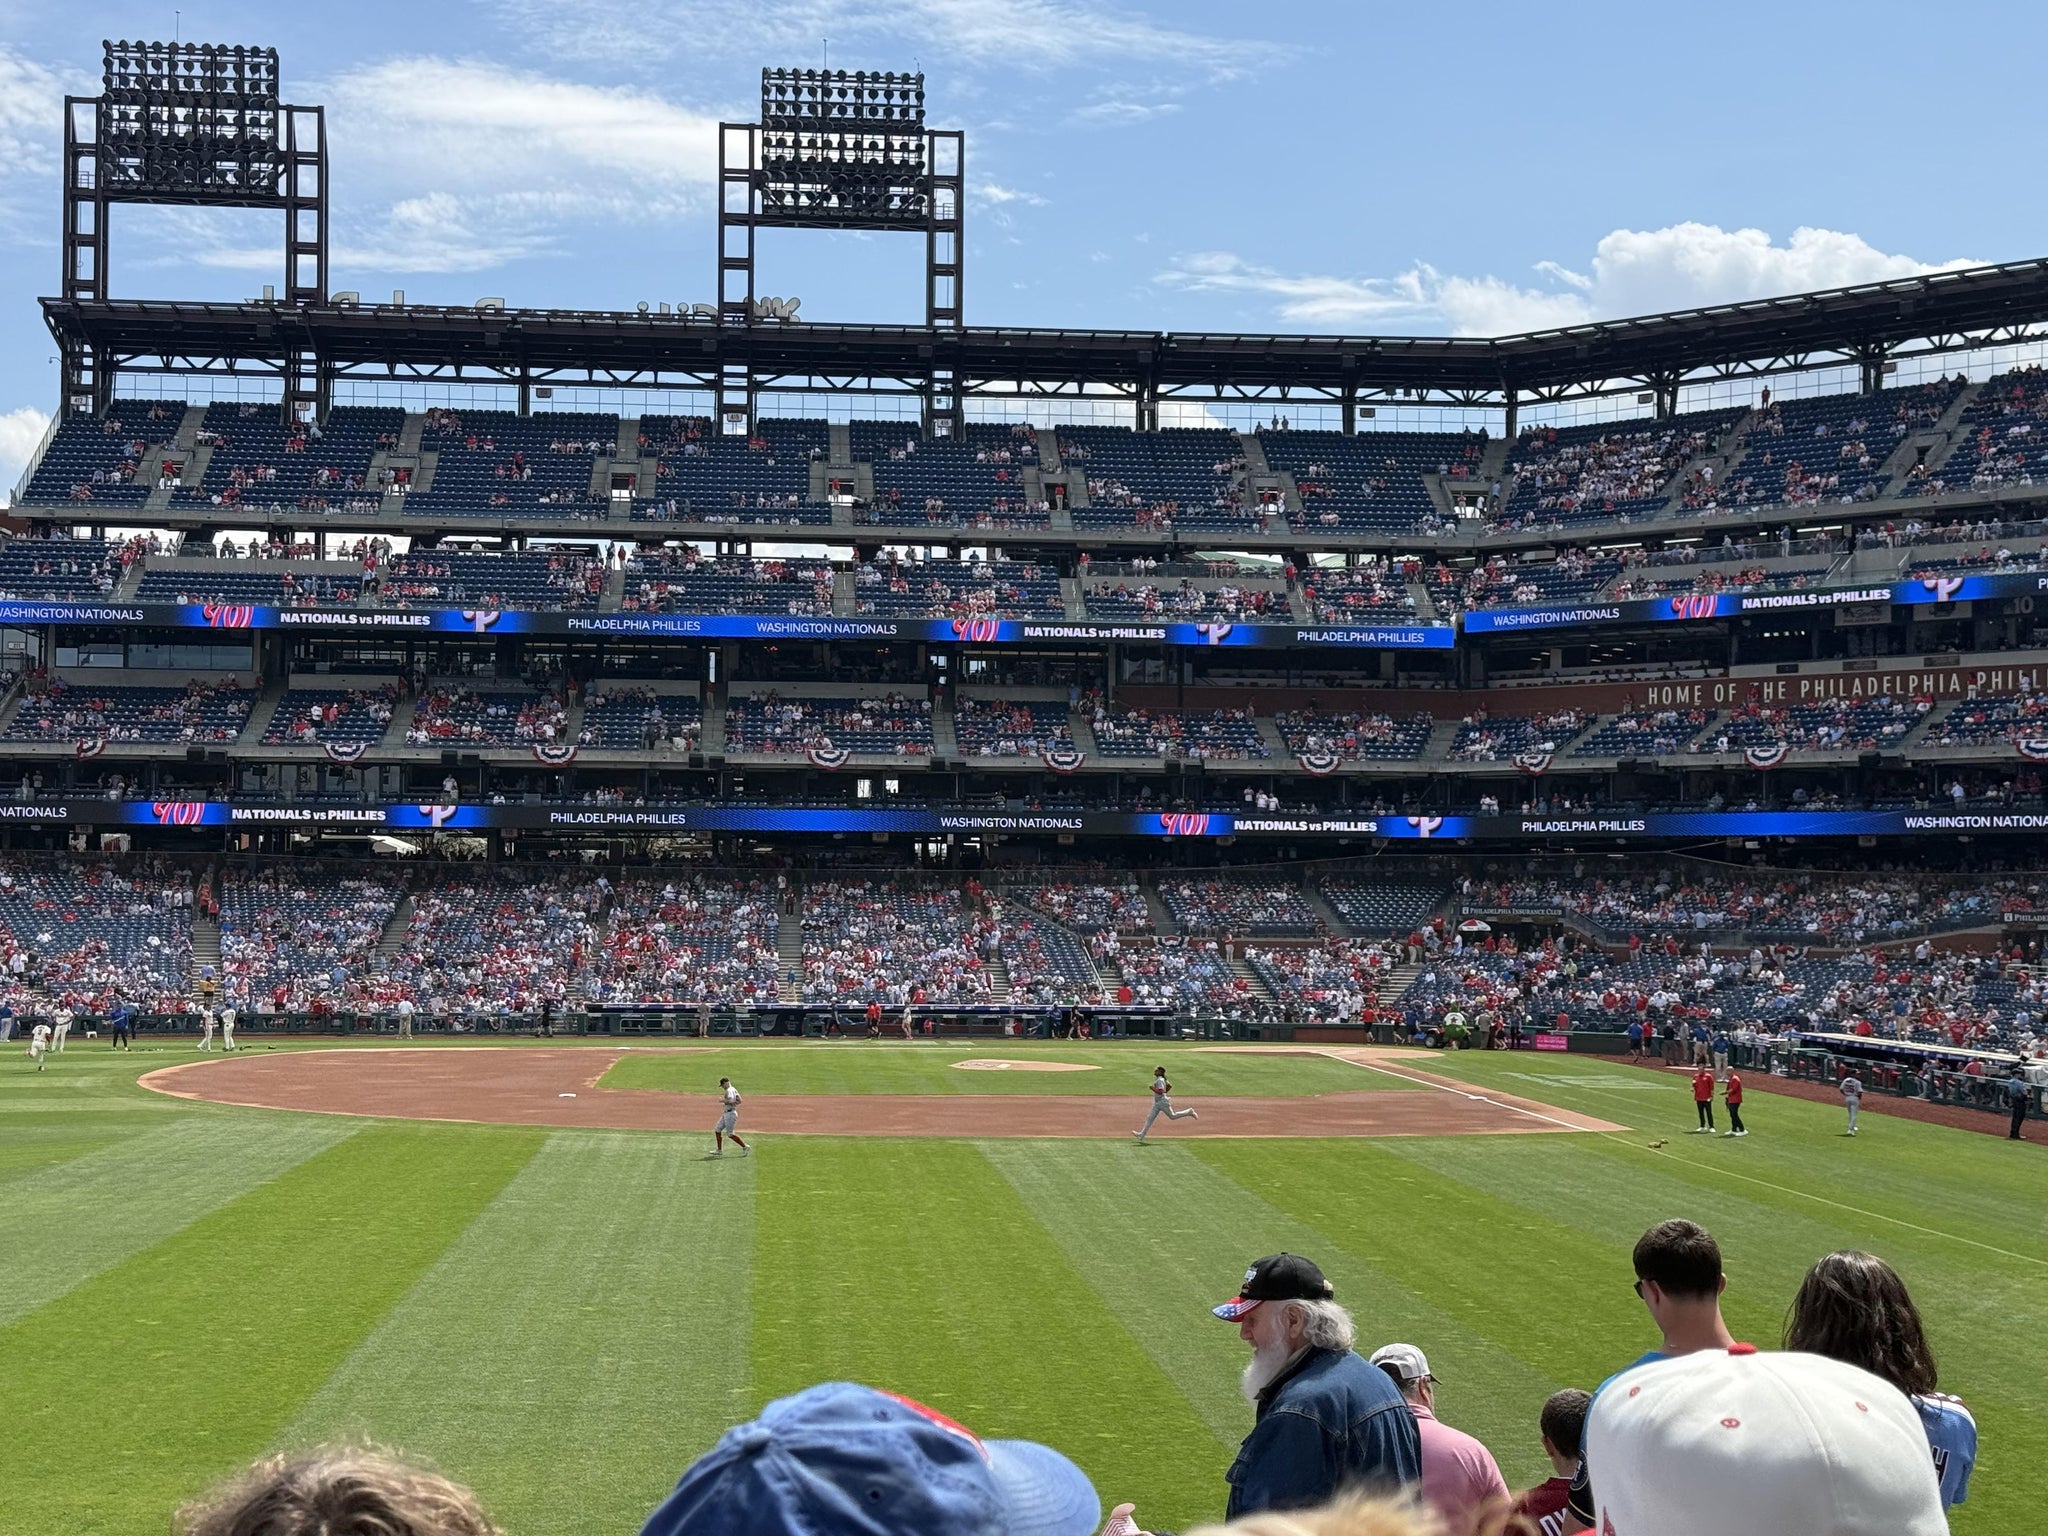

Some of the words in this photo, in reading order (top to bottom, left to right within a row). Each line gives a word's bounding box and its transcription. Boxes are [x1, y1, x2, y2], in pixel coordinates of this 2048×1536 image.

[1742, 594, 1817, 609] NATIONALS
[1818, 595, 1832, 604] vs
[1832, 588, 1891, 603] PHILLIES
[76, 609, 144, 620] NATIONALS
[280, 612, 357, 625] NATIONALS
[359, 616, 372, 625] vs
[374, 615, 431, 625] PHILLIES
[1493, 612, 1560, 626] WASHINGTON
[1561, 608, 1620, 622] NATIONALS
[568, 618, 650, 630] PHILADELPHIA
[652, 620, 700, 631] PHILLIES
[756, 622, 832, 633] WASHINGTON
[834, 624, 897, 635] NATIONALS
[1024, 626, 1097, 638] NATIONALS
[1098, 630, 1111, 639] vs
[1111, 628, 1166, 639] PHILLIES
[1297, 631, 1376, 642] PHILADELPHIA
[1377, 632, 1425, 643] PHILLIES
[1648, 685, 1702, 705] HOME
[1714, 683, 1737, 702] OF
[1800, 673, 1961, 698] PHILADELPHIA
[0, 806, 67, 818] NATIONALS
[231, 808, 311, 820] NATIONALS
[312, 811, 326, 821] vs
[327, 810, 386, 821] PHILLIES
[550, 812, 635, 824] PHILADELPHIA
[636, 814, 686, 825] PHILLIES
[940, 817, 1017, 828] WASHINGTON
[1018, 818, 1083, 830] NATIONALS
[1234, 820, 1307, 832] NATIONALS
[1308, 823, 1322, 832] vs
[1322, 821, 1378, 832] PHILLIES
[1521, 821, 1598, 832] PHILADELPHIA
[1599, 820, 1646, 831] PHILLIES
[1904, 816, 1990, 828] WASHINGTON
[1470, 907, 1511, 915] PHILADELPHIA
